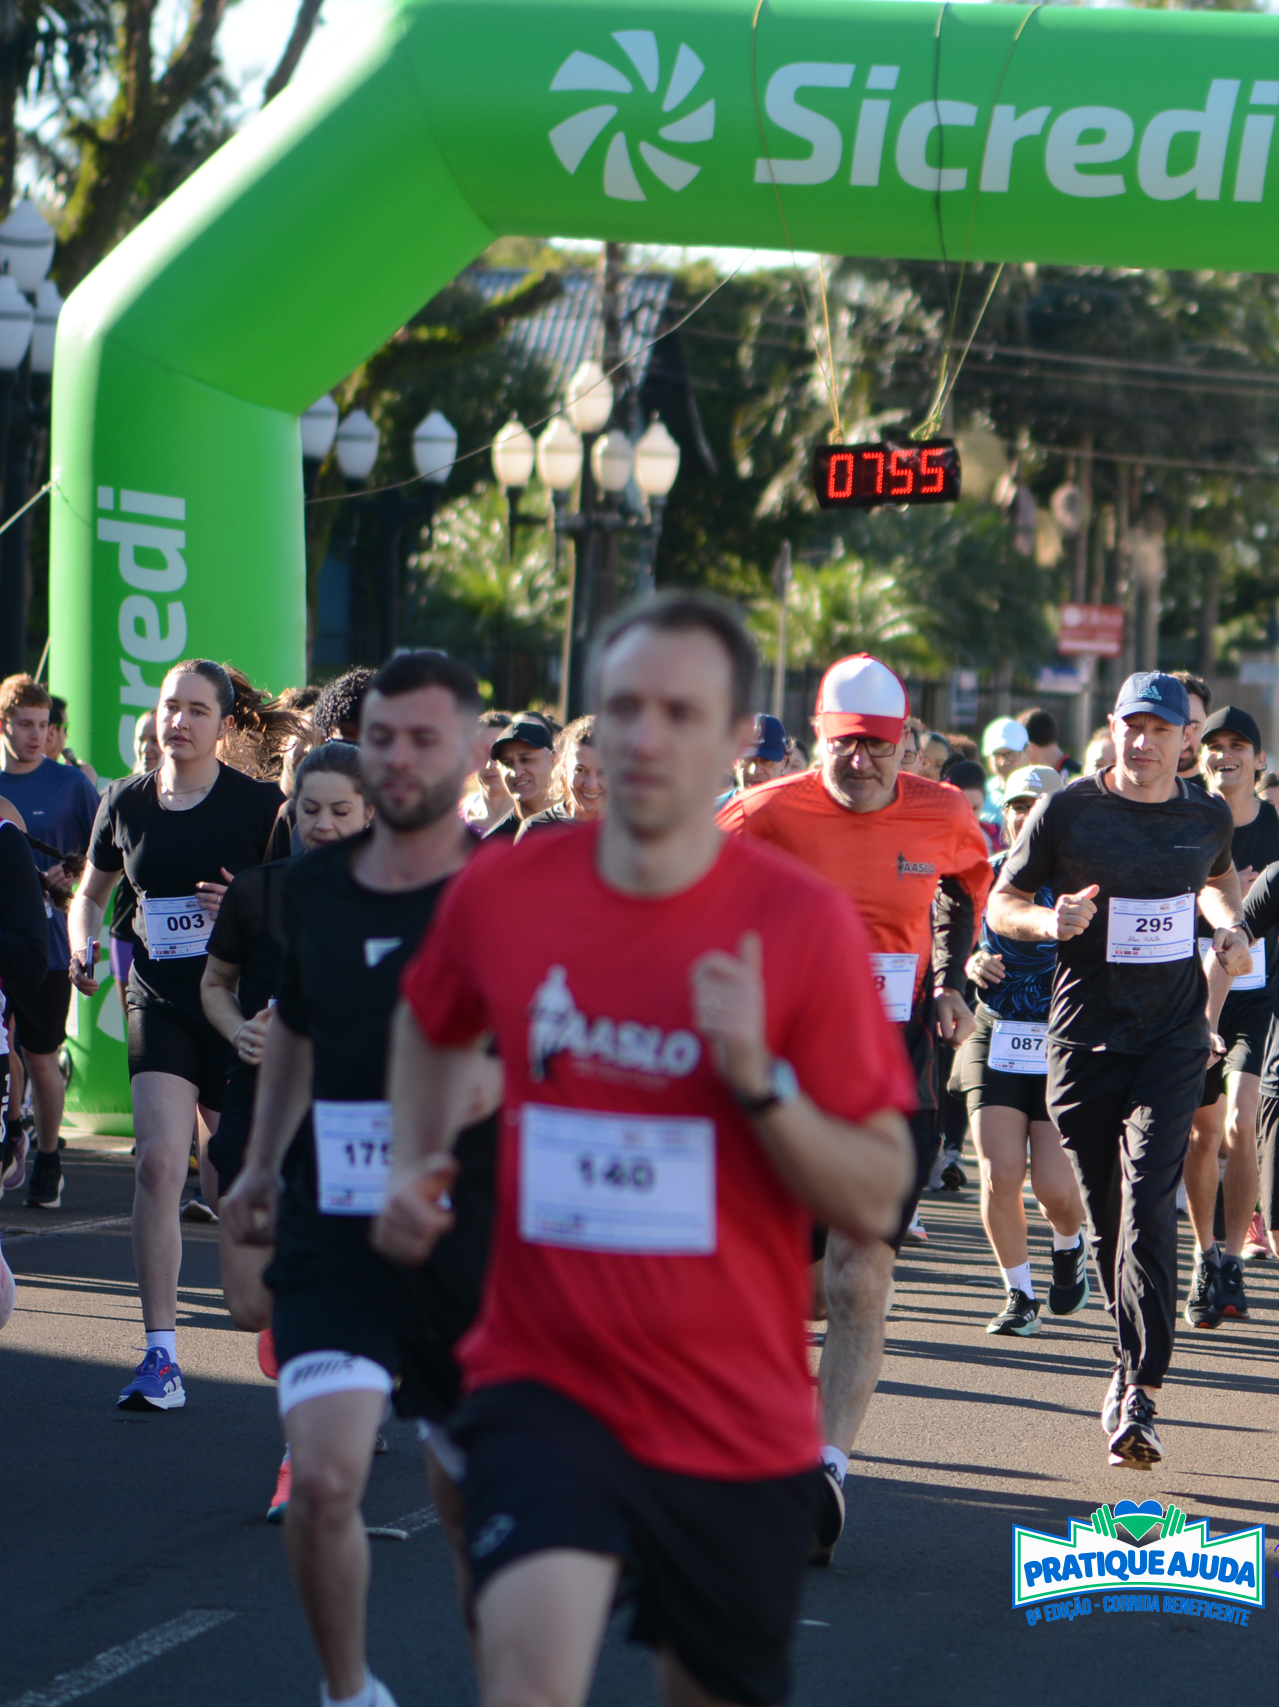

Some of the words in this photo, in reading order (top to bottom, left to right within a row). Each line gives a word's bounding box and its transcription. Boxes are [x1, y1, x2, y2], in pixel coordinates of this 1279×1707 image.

[828, 447, 944, 498] 0755
[1137, 691, 1163, 701] adidas
[167, 914, 205, 932] 003
[1135, 916, 1173, 933] 295
[1011, 1036, 1044, 1051] 087
[579, 1153, 656, 1194] 140
